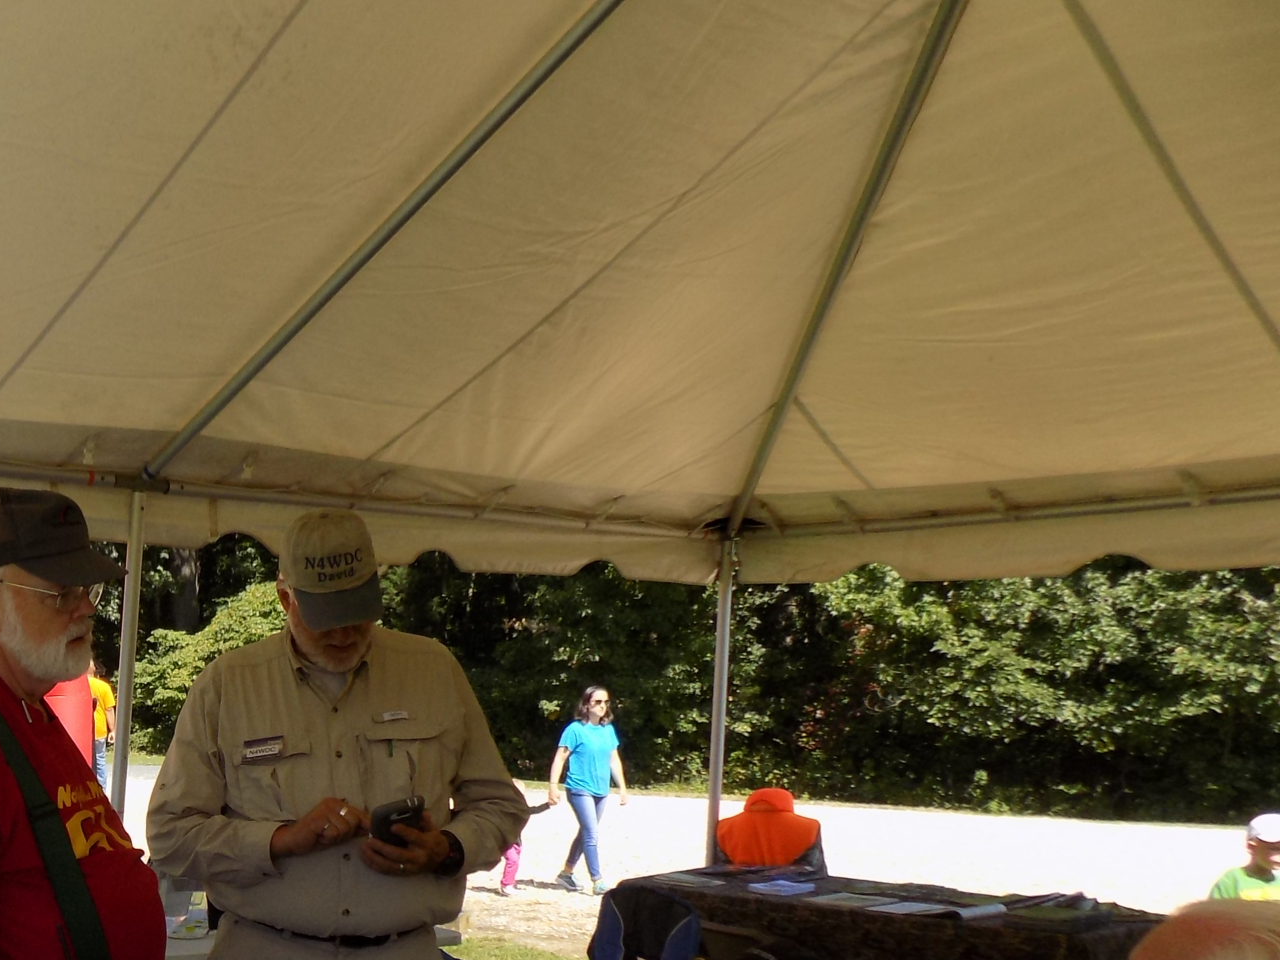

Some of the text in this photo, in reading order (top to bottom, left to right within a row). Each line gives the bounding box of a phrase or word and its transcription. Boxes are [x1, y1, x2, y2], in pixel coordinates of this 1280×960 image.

[304, 548, 363, 570] N4WDC
[317, 567, 355, 583] David
[248, 746, 277, 756] N4WDC
